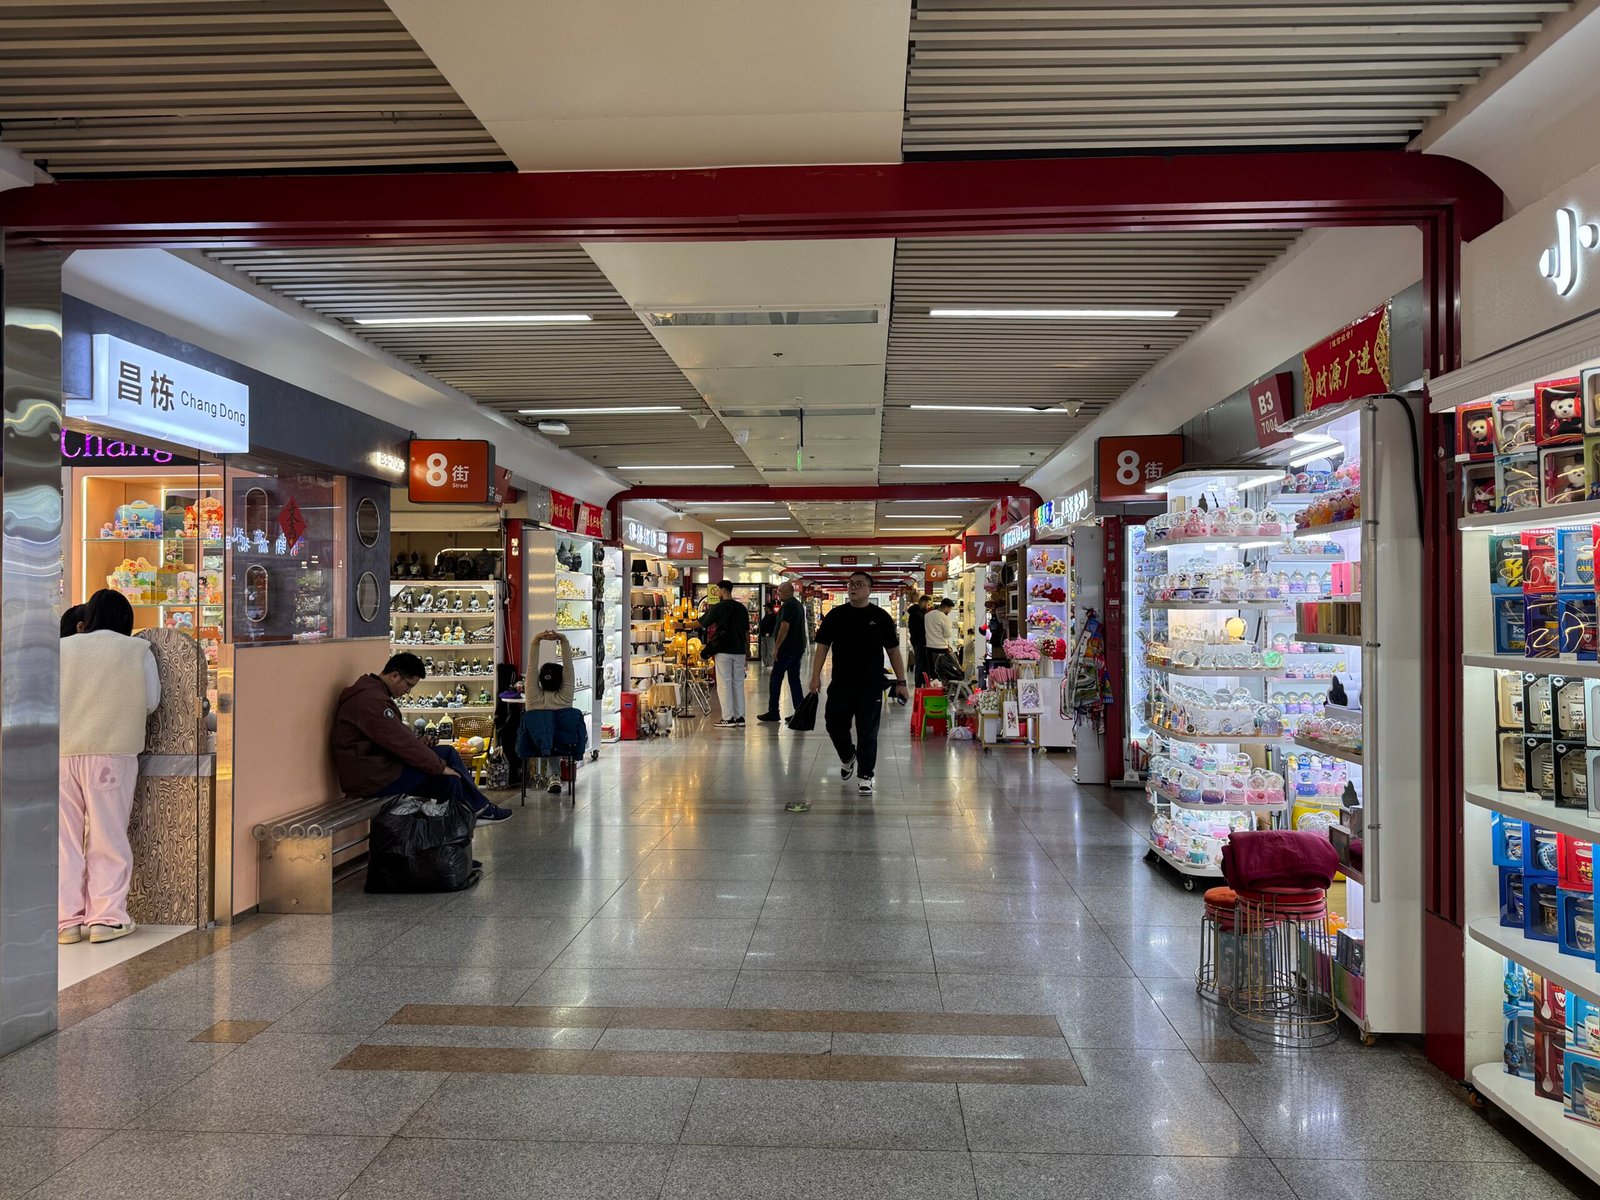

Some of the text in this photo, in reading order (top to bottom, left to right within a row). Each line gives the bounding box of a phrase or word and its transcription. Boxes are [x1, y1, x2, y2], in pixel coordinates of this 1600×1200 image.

[118, 361, 175, 411] 昌栋
[1316, 340, 1373, 398] 财源广进
[181, 391, 246, 426] Chang Dong
[1258, 391, 1274, 415] B3
